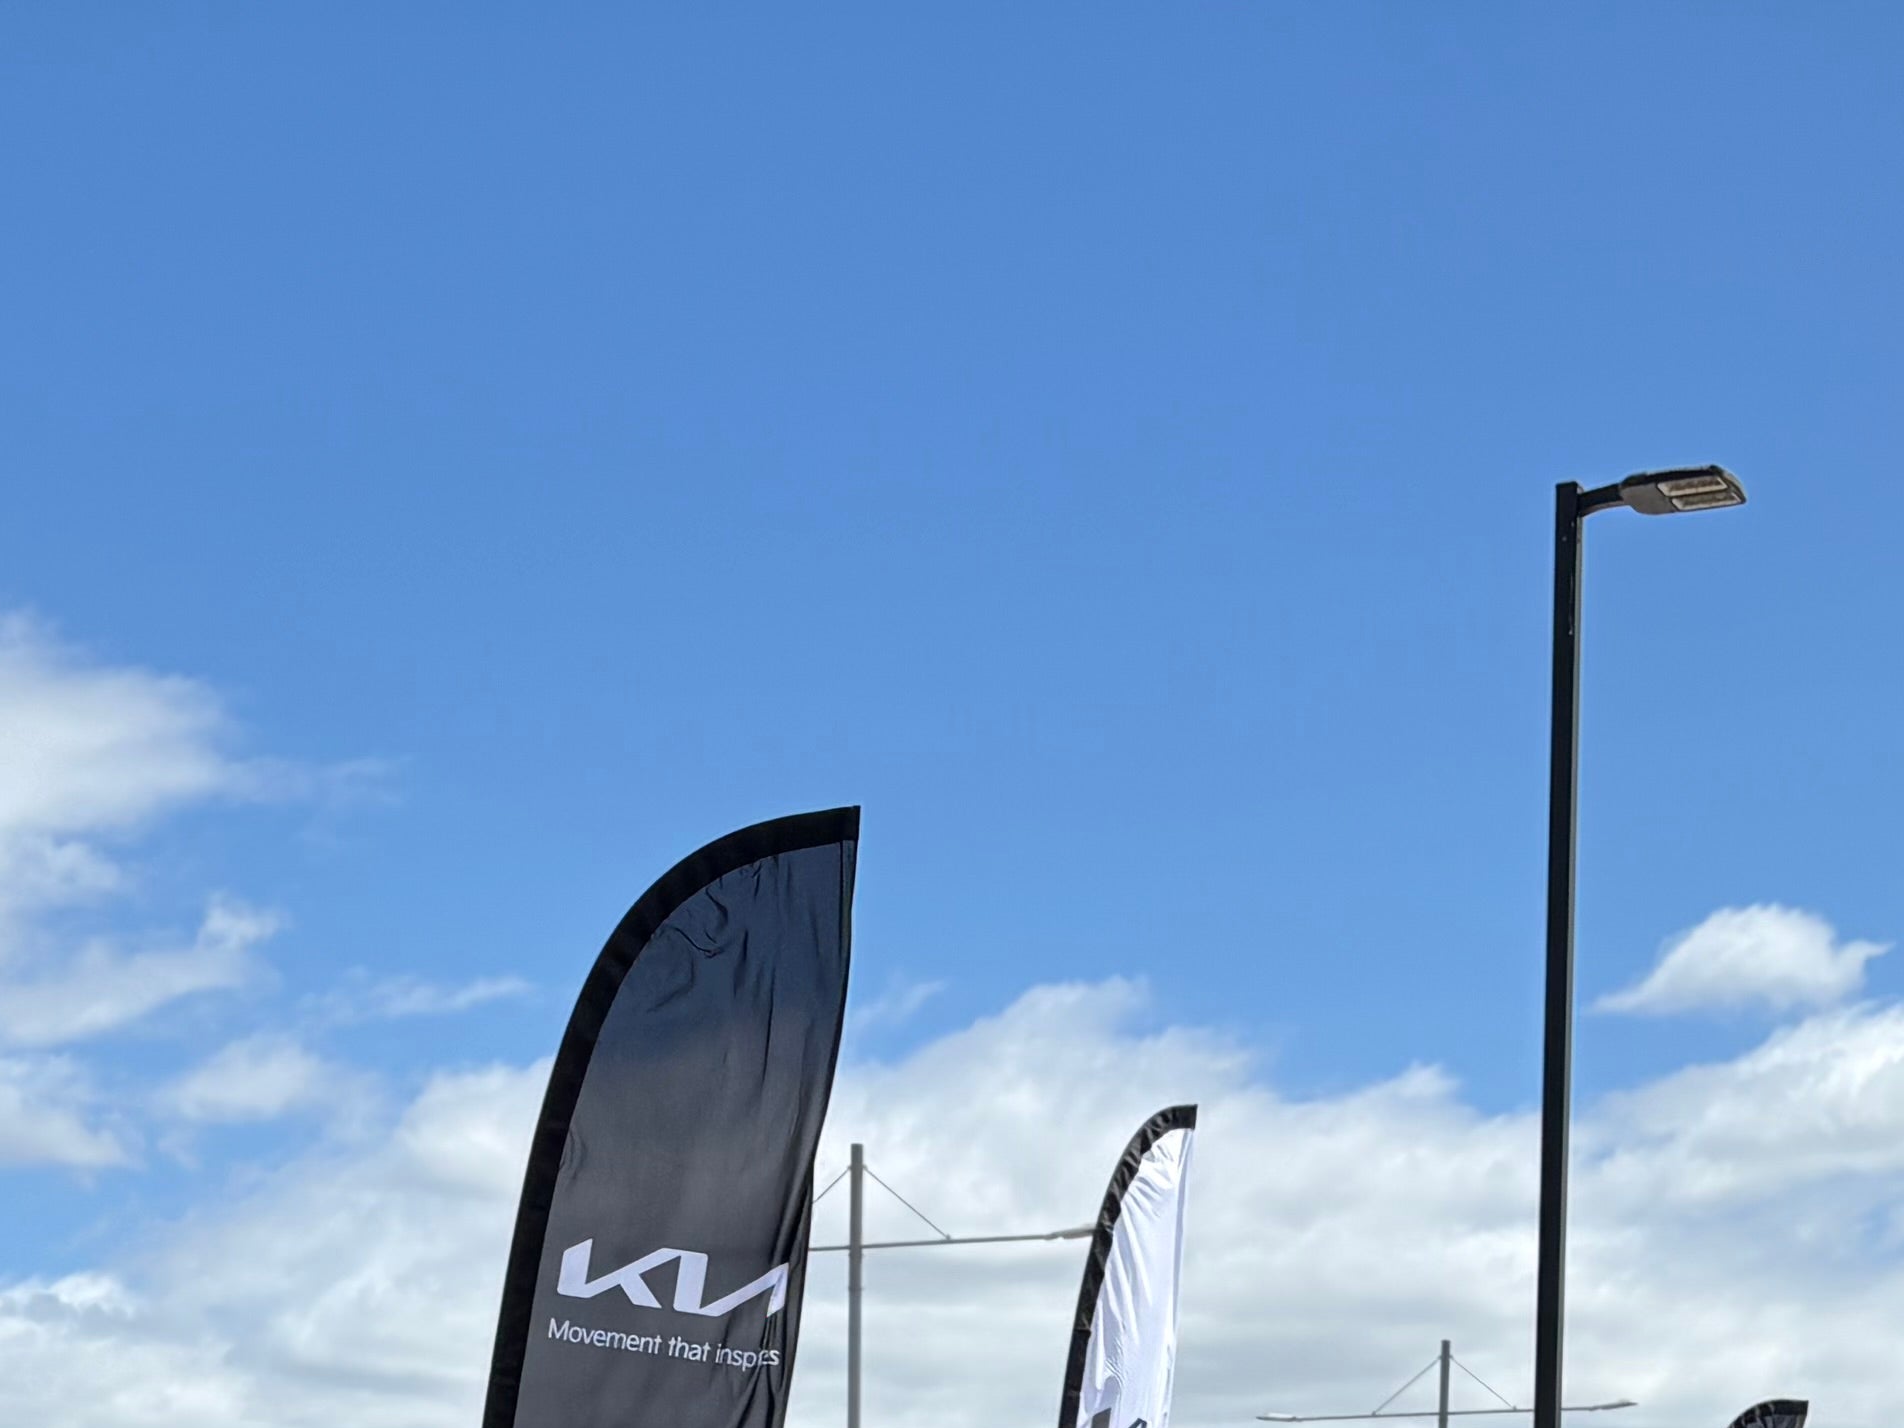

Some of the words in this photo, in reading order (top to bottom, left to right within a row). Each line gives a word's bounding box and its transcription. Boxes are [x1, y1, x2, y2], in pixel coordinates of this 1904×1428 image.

[557, 1238, 789, 1318] KIA
[548, 1317, 663, 1355] Movement
[668, 1336, 711, 1363] that
